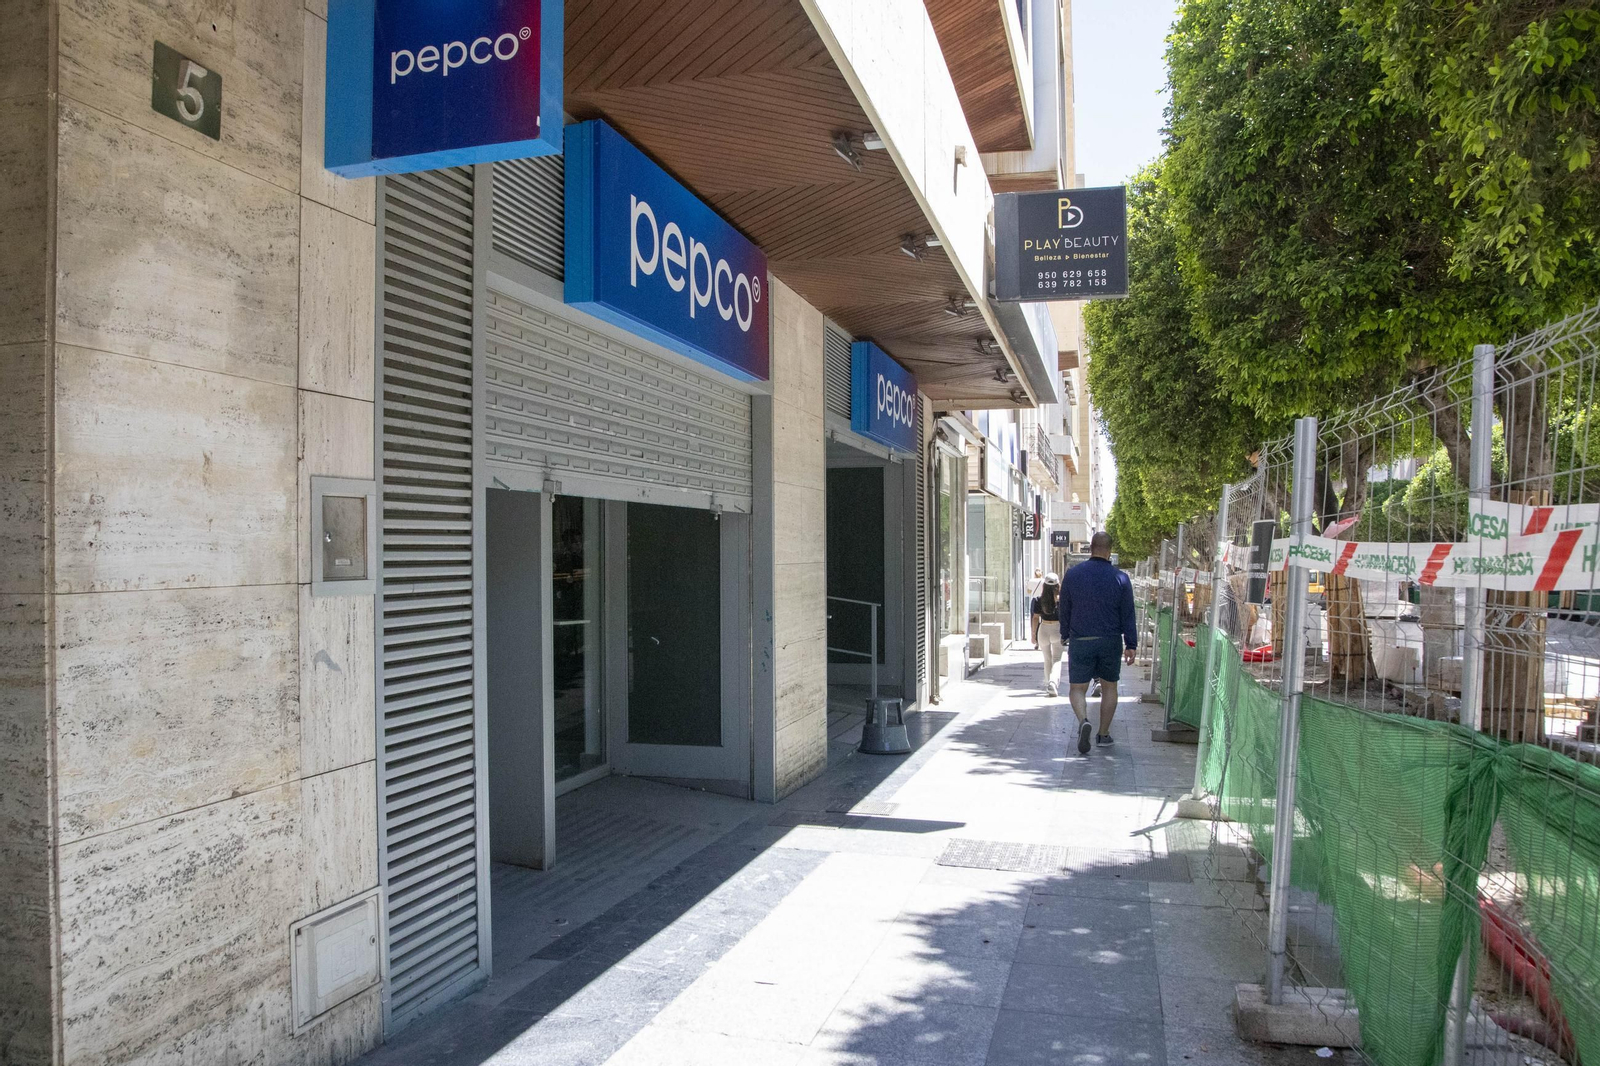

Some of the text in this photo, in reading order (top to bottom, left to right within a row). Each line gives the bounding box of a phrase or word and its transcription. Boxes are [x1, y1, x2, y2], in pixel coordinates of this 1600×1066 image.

[390, 32, 520, 85] pepco
[176, 60, 205, 122] 5
[630, 193, 753, 333] pepco
[1034, 252, 1110, 262] Belleza Bienestar
[1038, 269, 1107, 280] 950 629 658
[1038, 278, 1107, 289] 639 782 158
[877, 372, 914, 429] pepco
